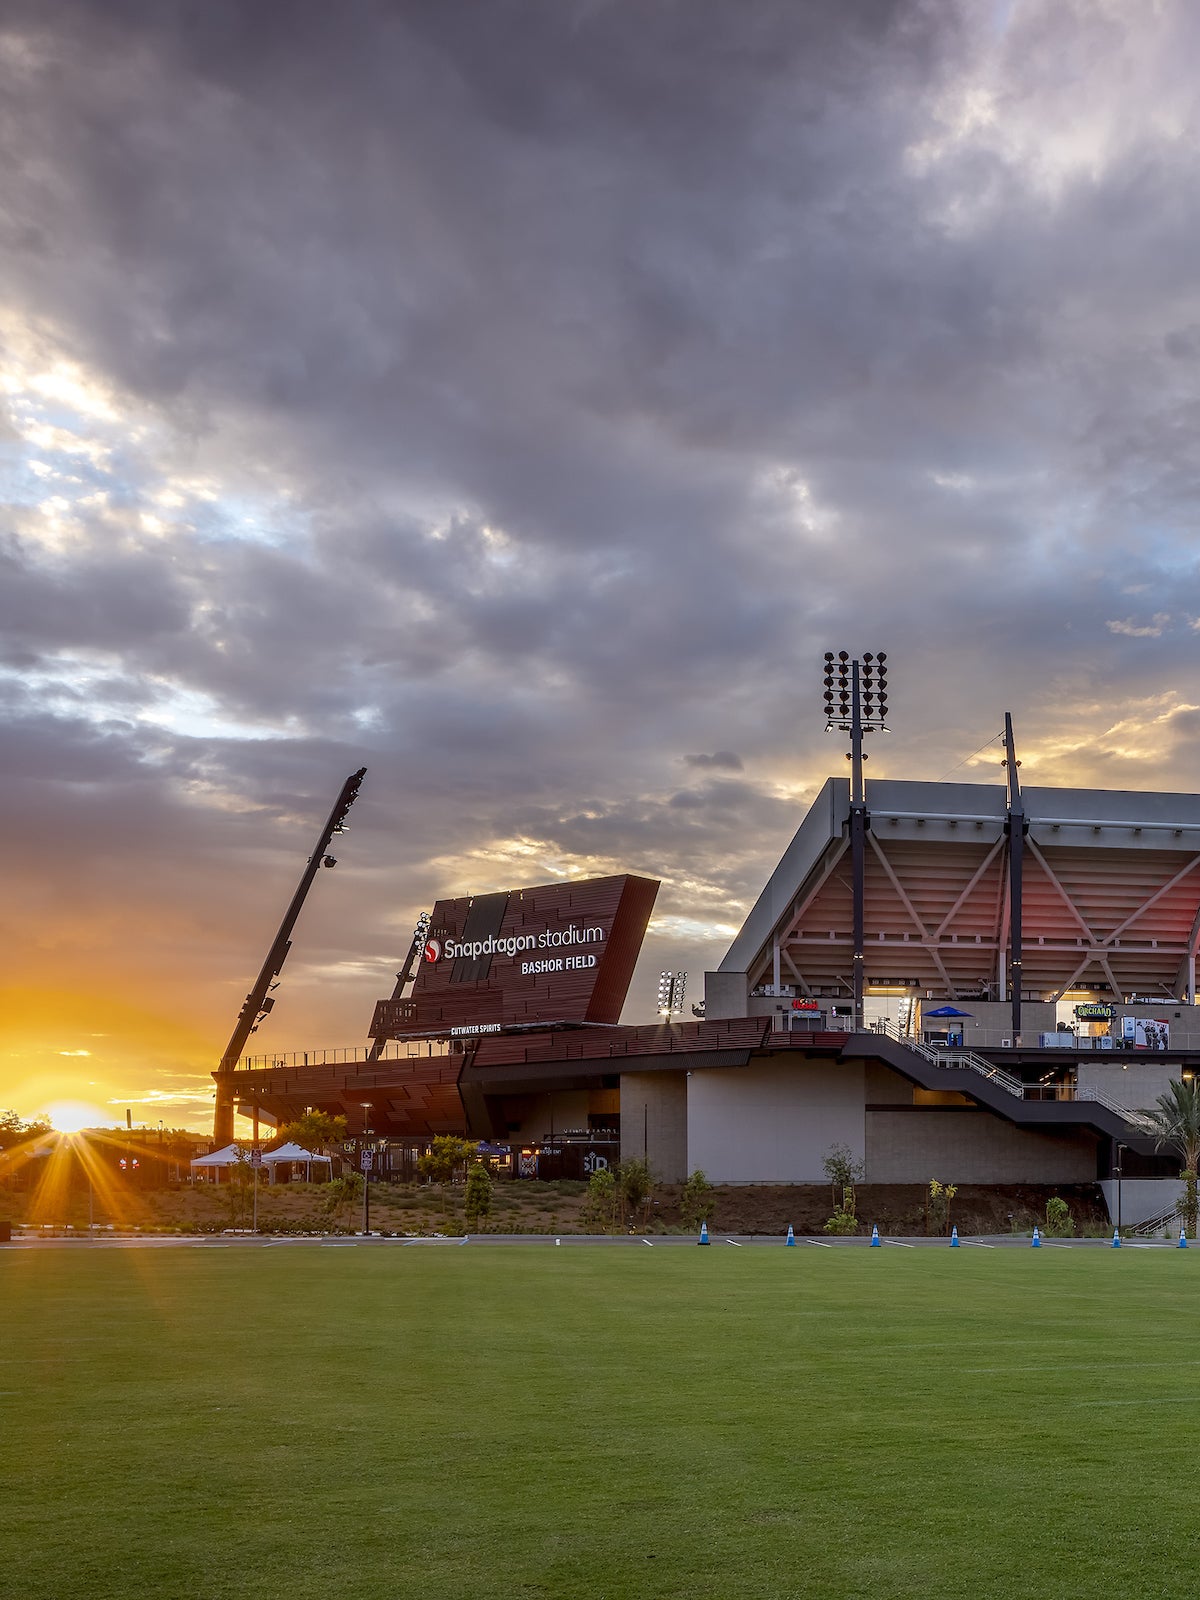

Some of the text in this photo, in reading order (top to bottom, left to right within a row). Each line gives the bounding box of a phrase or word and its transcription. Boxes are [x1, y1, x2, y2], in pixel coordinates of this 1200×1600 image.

[444, 924, 604, 960] Snapdragon stadium
[521, 954, 596, 975] BASHOR FIELD
[480, 1023, 501, 1034] SPIRITS
